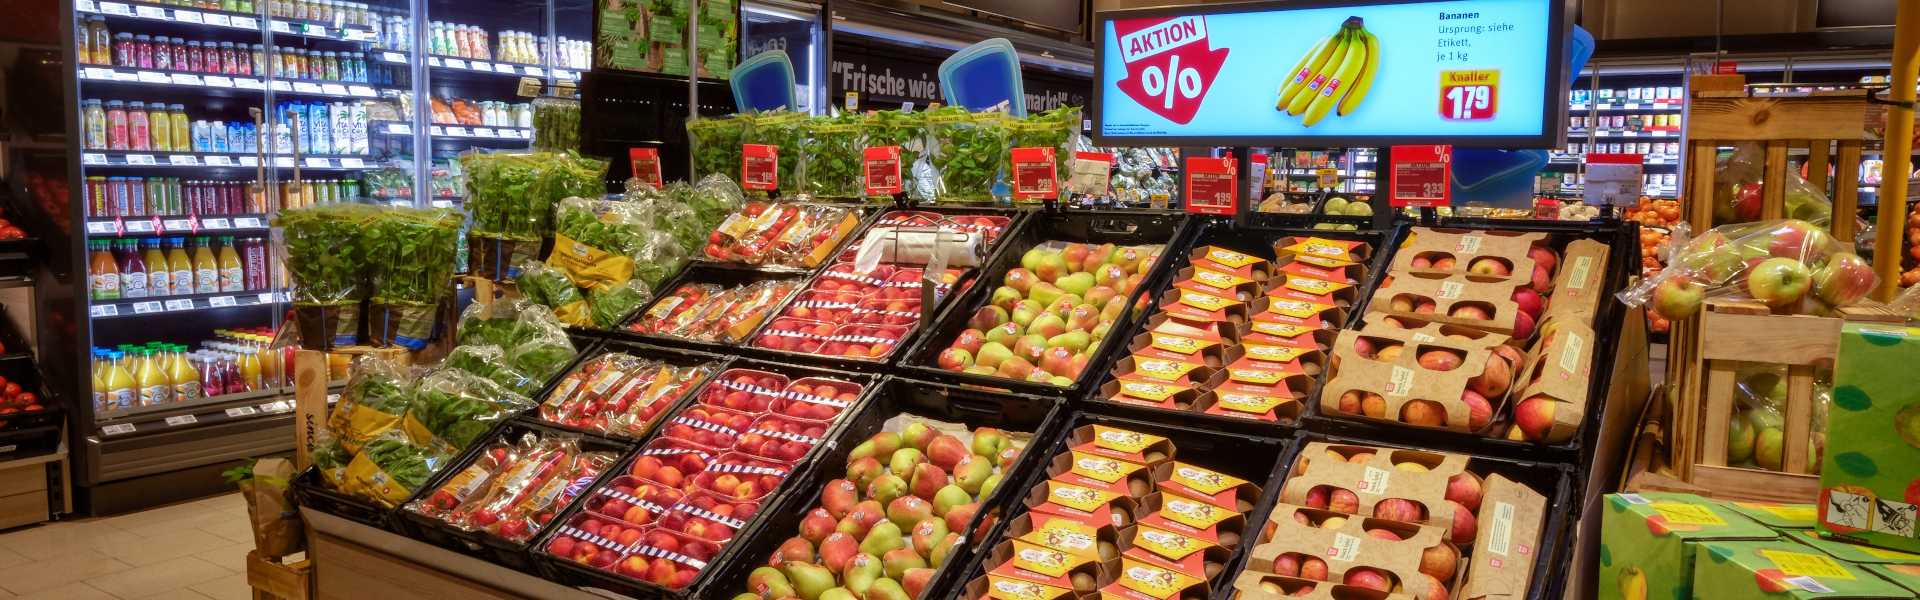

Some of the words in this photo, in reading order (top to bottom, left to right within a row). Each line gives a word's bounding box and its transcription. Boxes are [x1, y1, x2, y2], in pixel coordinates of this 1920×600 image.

[1439, 12, 1480, 20] Bananen
[1438, 24, 1485, 35] Ursprung:
[1488, 23, 1514, 32] siehe
[1129, 18, 1197, 57] AKTION
[1438, 38, 1471, 48] Etikett,
[1436, 51, 1446, 62] je
[1457, 51, 1468, 62] kg
[1449, 71, 1491, 82] Knaller
[907, 72, 936, 100] wie
[305, 413, 317, 453] since
